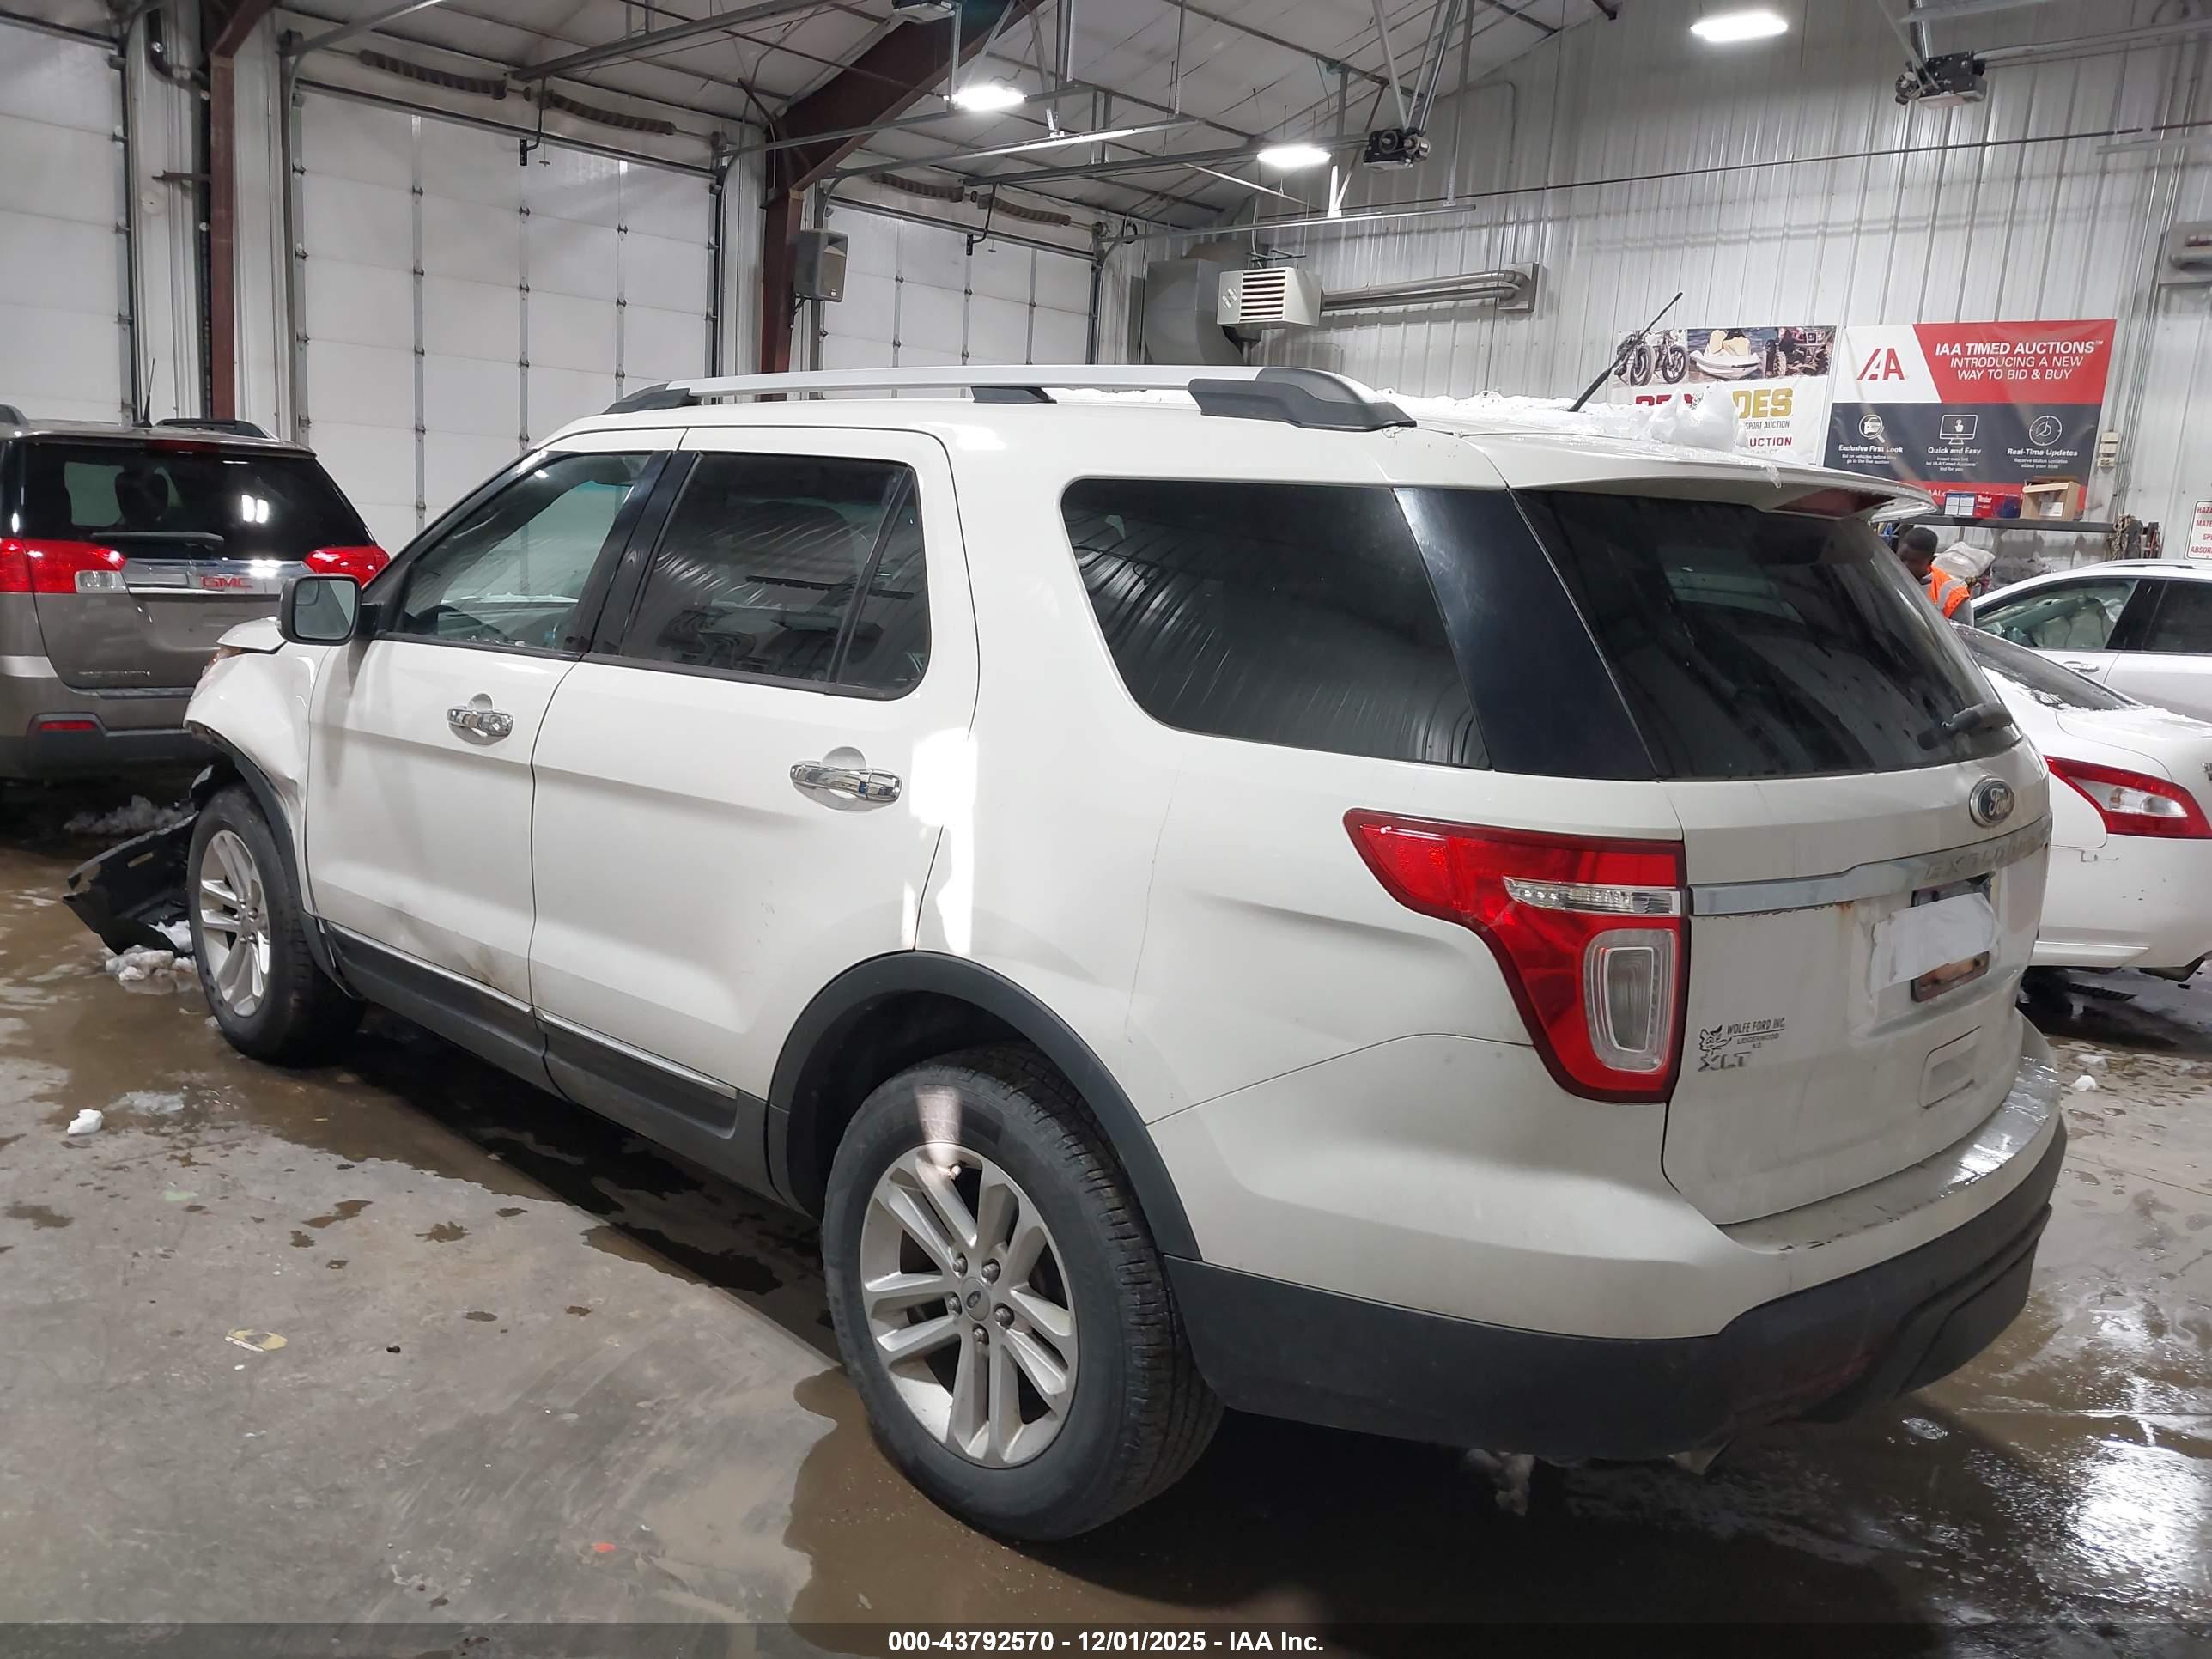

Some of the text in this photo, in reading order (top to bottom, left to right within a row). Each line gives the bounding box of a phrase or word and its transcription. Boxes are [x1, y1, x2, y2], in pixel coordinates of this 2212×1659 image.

[1936, 343, 1961, 356] IAA
[1966, 342, 2010, 356] TIMED
[1950, 356, 2084, 368] INTRODUCING A NEW
[1957, 368, 2073, 380] WAY TO BID & BUY
[1733, 387, 1794, 420] DES
[1764, 420, 1790, 429] AUCTION
[1749, 436, 1793, 447] UCTION
[1965, 447, 1982, 456] Easy
[2045, 449, 2078, 458] Updates
[201, 576, 253, 588] GMC
[1989, 787, 2011, 816] Ford
[1727, 1022, 1752, 1035] WOLFE
[1753, 1019, 1771, 1031] FORD
[1698, 1051, 1753, 1072] XLT
